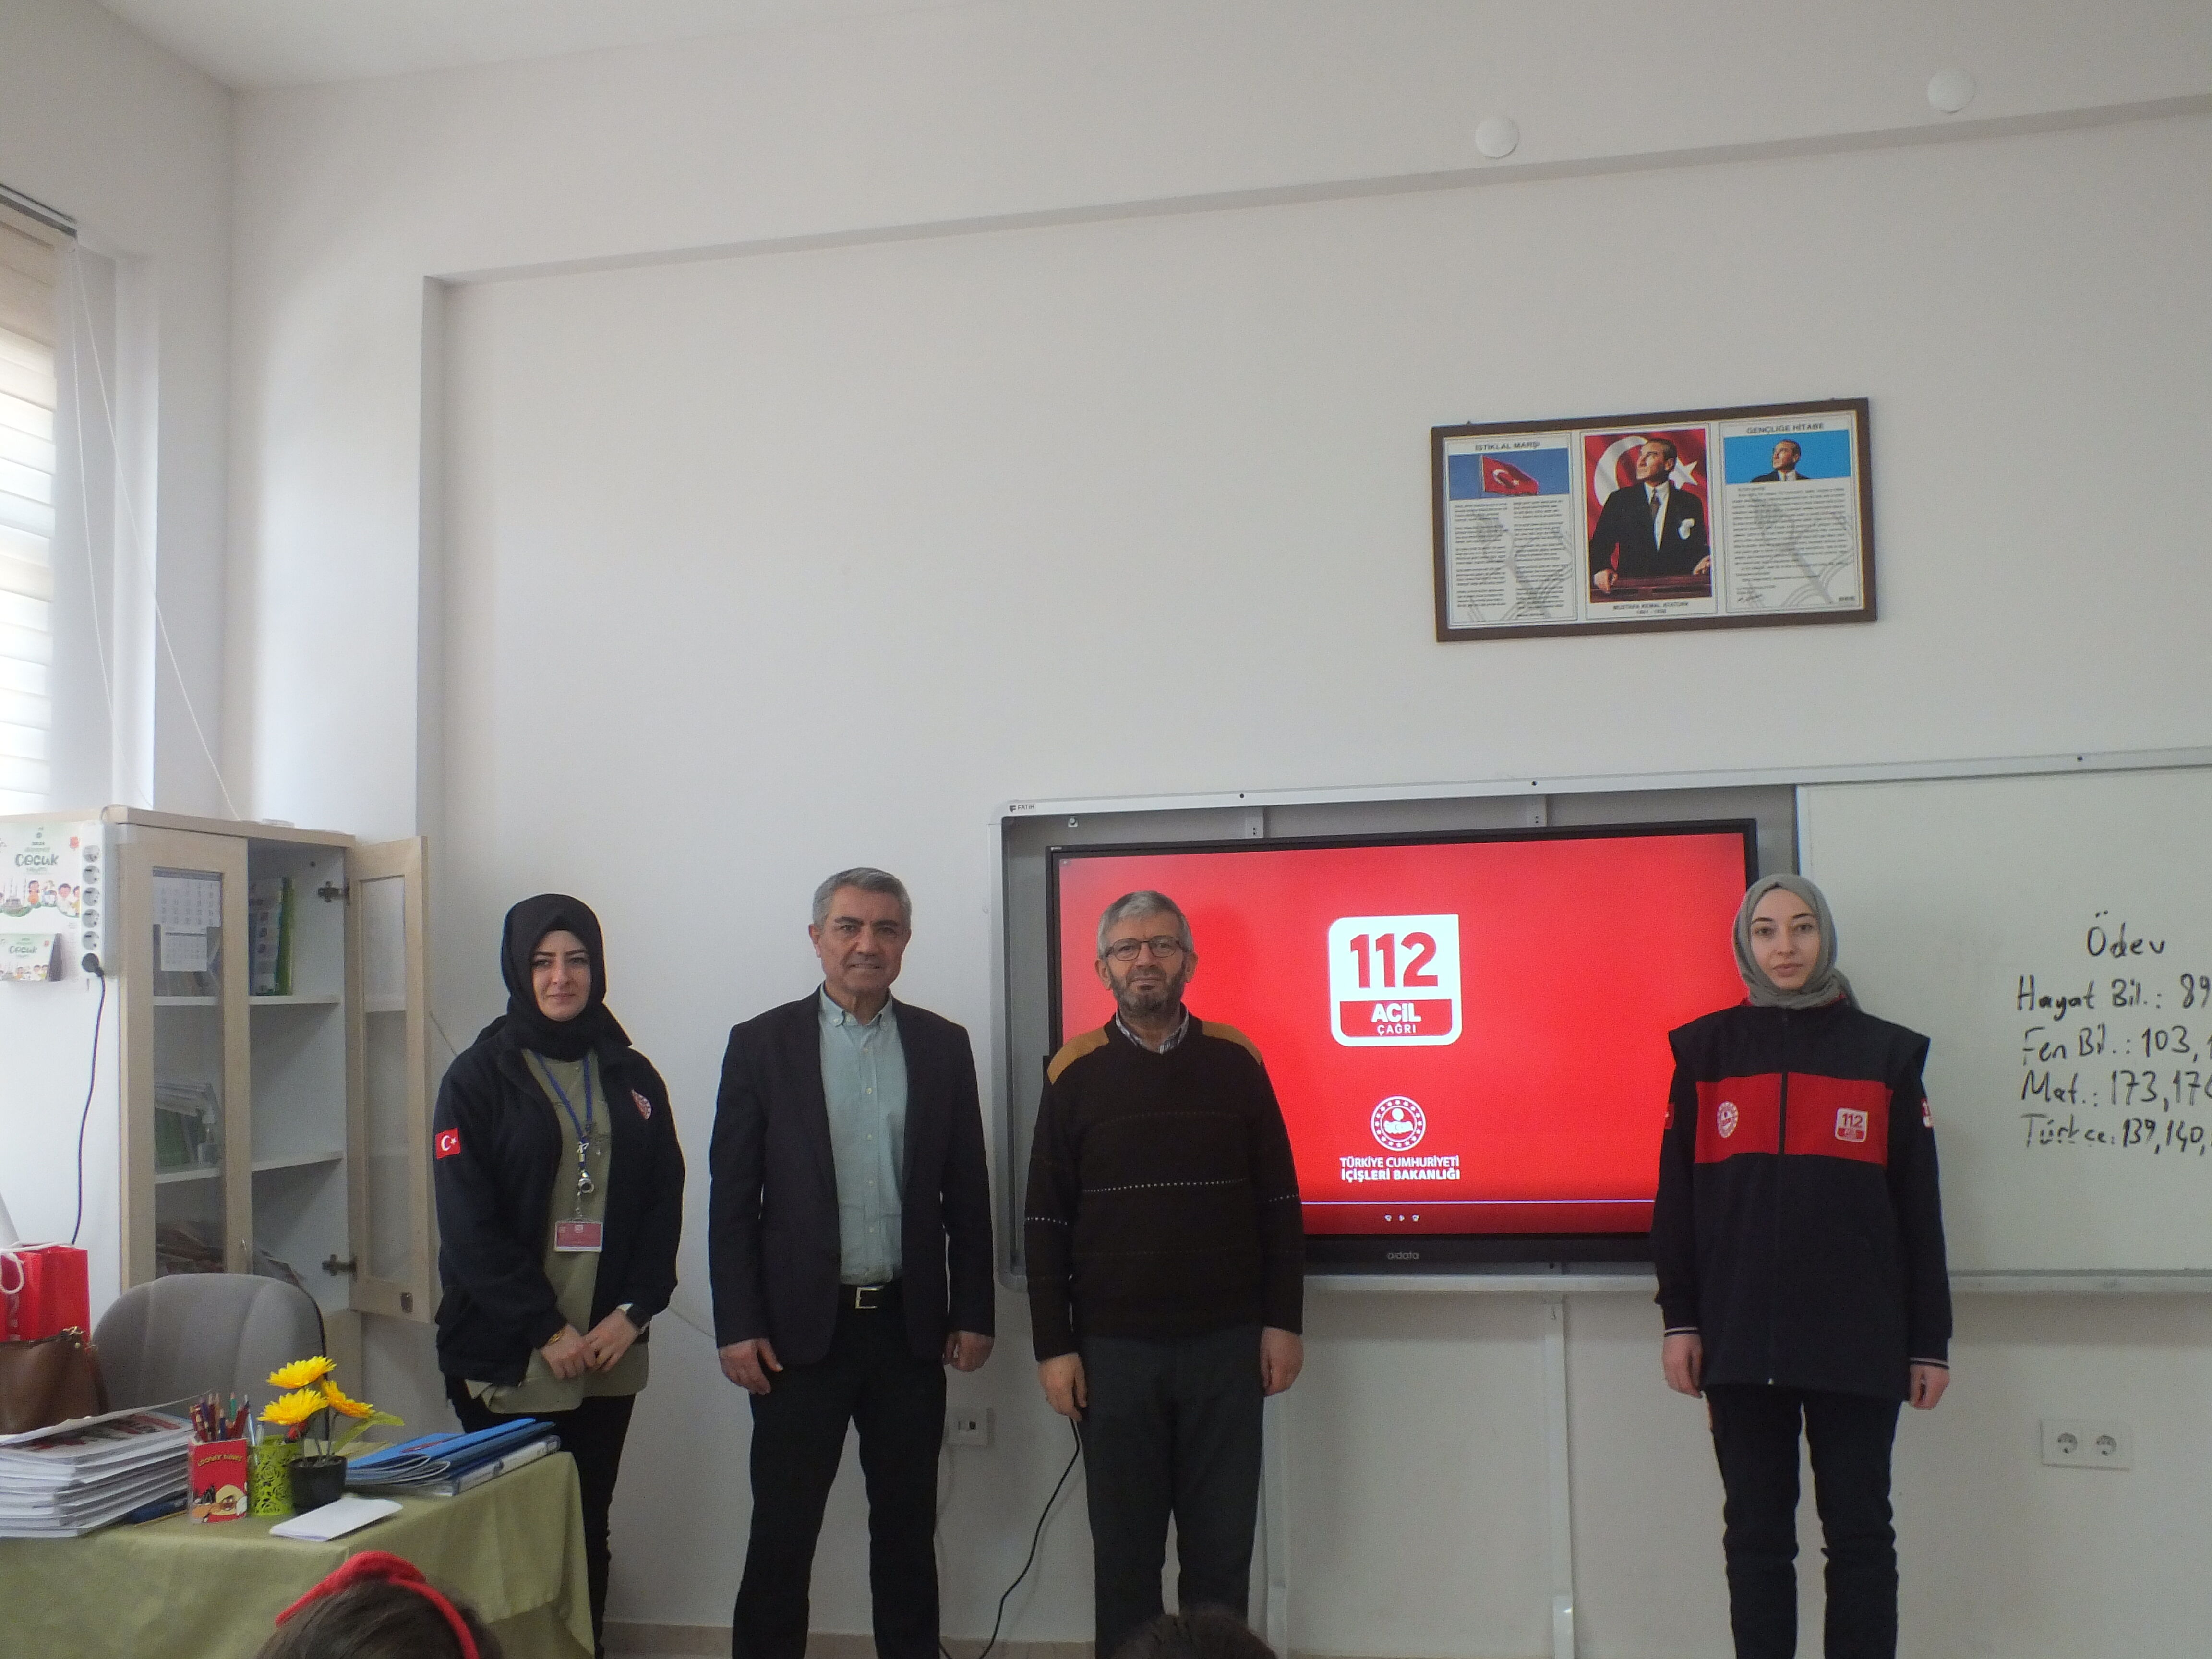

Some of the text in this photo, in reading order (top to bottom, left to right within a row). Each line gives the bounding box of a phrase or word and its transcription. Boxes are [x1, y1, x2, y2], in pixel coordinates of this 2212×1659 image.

[2086, 910, 2166, 959] Ödev
[1350, 931, 1438, 989] 112
[2016, 974, 2095, 1022] Hayat
[1371, 1002, 1422, 1023] ACİL
[1377, 1023, 1416, 1036] ÇAĞRI
[2022, 1025, 2067, 1066] Fen
[1842, 1113, 1863, 1128] 112
[1339, 1155, 1459, 1168] TÜRKİYE CUMHURİYETİ
[1341, 1167, 1460, 1183] İÇİŞLERİ BAKANLIĞI
